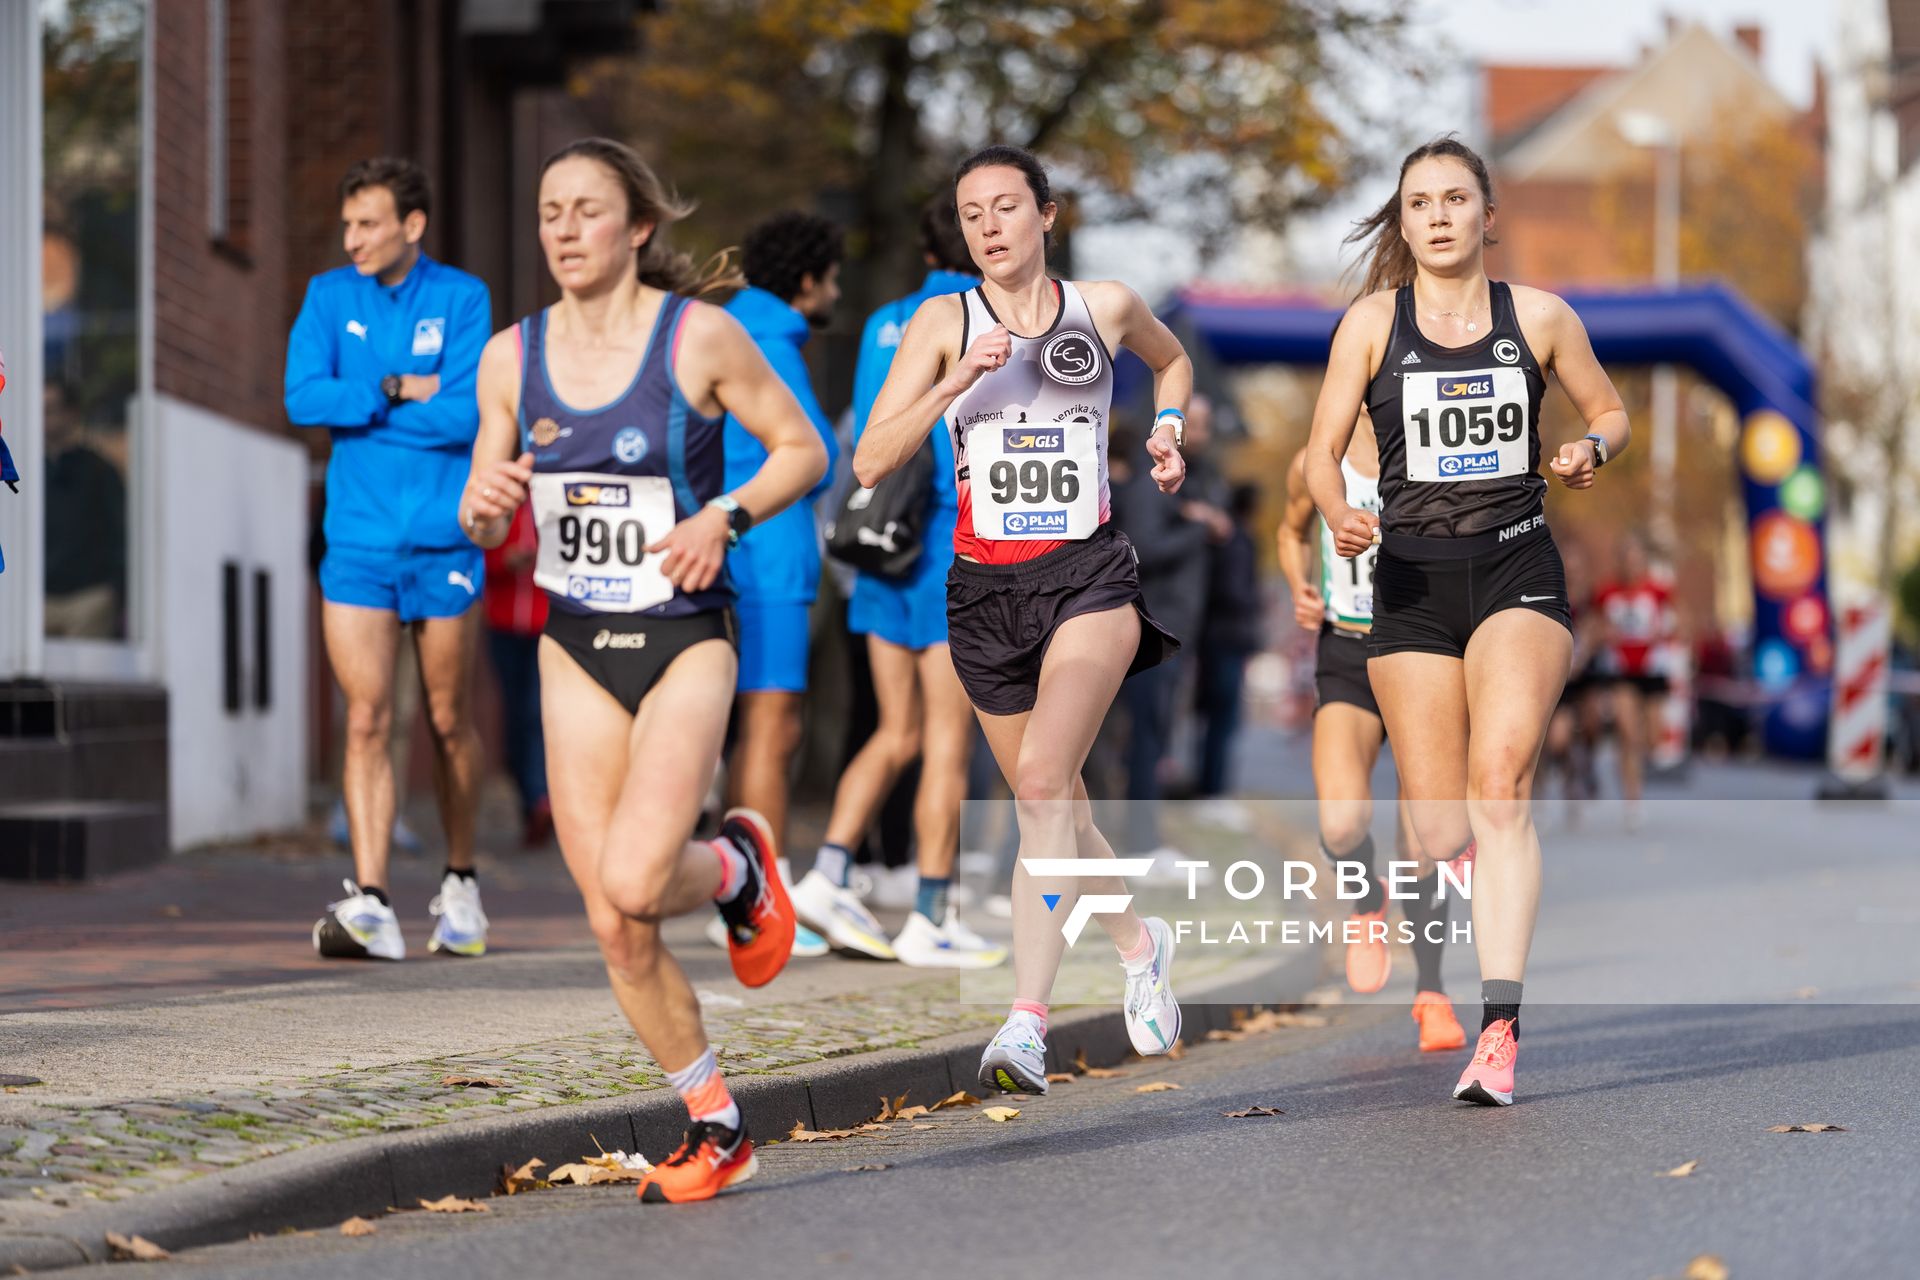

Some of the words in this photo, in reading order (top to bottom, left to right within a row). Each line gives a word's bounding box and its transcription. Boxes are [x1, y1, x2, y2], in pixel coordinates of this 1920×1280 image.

[1467, 381, 1490, 395] GLS
[963, 409, 1004, 426] Laufsport
[1411, 402, 1524, 448] 1059
[1035, 435, 1059, 448] GLS
[1463, 455, 1497, 467] PLAN
[989, 459, 1080, 505] 996
[1029, 515, 1064, 526] PLAN
[1499, 519, 1531, 542] NIKE
[559, 515, 646, 567] 990
[590, 578, 630, 594] PLAN
